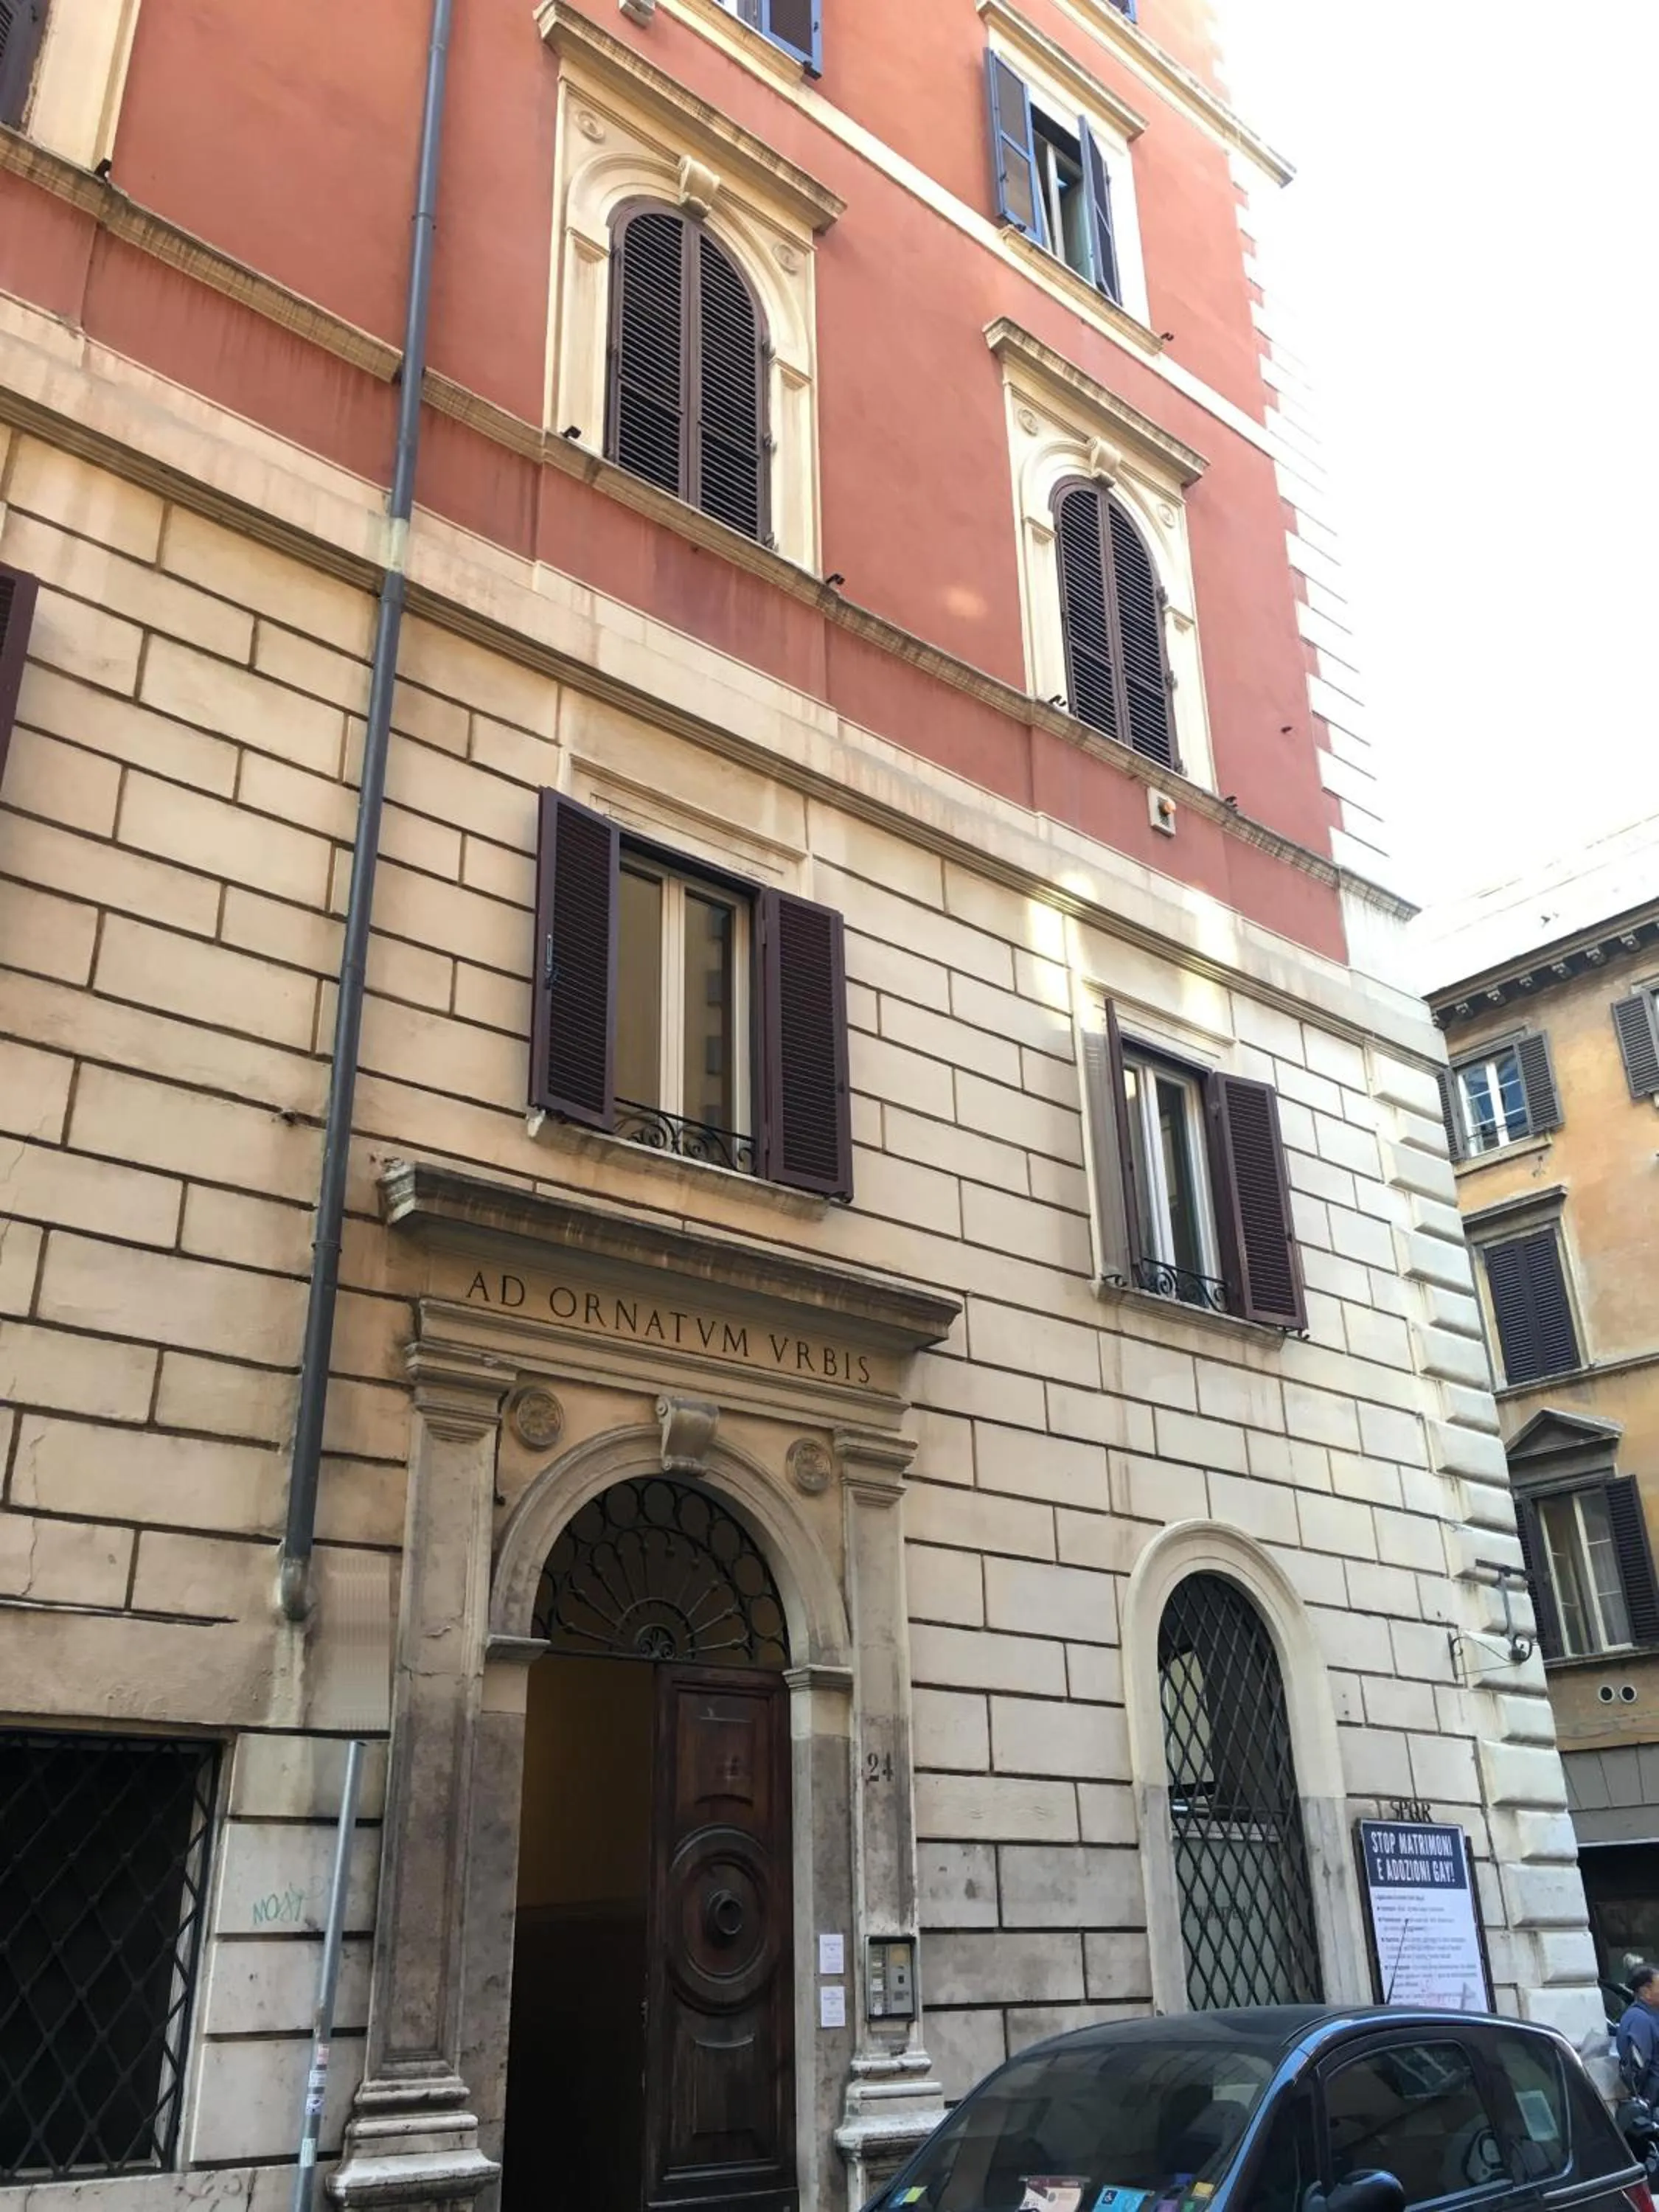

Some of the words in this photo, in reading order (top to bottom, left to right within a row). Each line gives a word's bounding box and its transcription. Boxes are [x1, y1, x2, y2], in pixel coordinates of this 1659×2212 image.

[465, 1270, 526, 1308] AD
[549, 1286, 750, 1358] ORNATVM
[770, 1334, 871, 1384] VRBIS
[866, 1752, 894, 1784] 24
[1390, 1798, 1434, 1823] SPQR
[1371, 1831, 1396, 1854] STOP
[1399, 1832, 1453, 1857] MATRIMONI
[1376, 1857, 1385, 1881] E
[1386, 1858, 1431, 1882] ADOZIONI
[1433, 1860, 1455, 1882] GAY!
